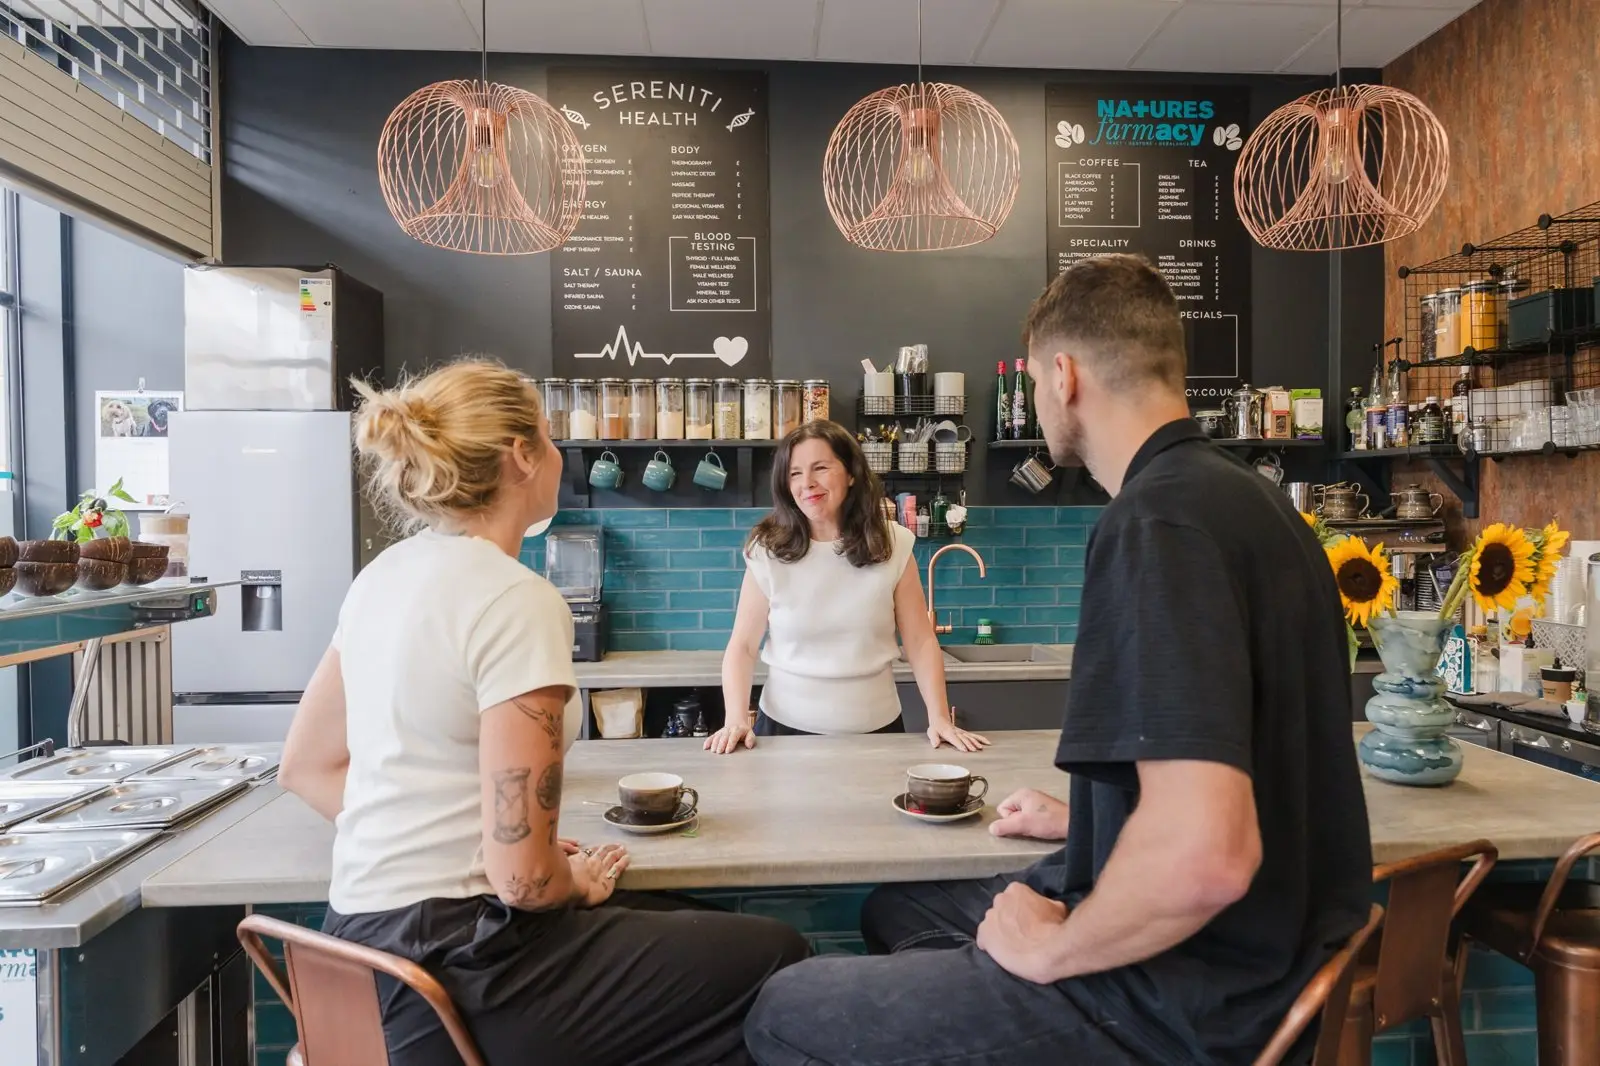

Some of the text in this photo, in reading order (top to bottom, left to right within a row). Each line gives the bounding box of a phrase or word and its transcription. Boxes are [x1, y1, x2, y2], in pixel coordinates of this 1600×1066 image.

[593, 80, 722, 113] SERENITI
[619, 111, 697, 126] HEALTH
[1088, 114, 1206, 146] farmacy
[562, 144, 608, 153] OXYGEN
[671, 145, 700, 154] BODY
[1079, 158, 1120, 167] COFFEE
[1188, 159, 1208, 168] TEA
[562, 200, 607, 209] ENERGY
[694, 232, 731, 240] BLOOD
[690, 242, 736, 251] TESTING
[1070, 238, 1129, 247] SPECIALITY
[1179, 239, 1217, 248] DRINKS
[563, 266, 642, 278] SALT / SAUNA
[1180, 310, 1223, 319] PECIALS
